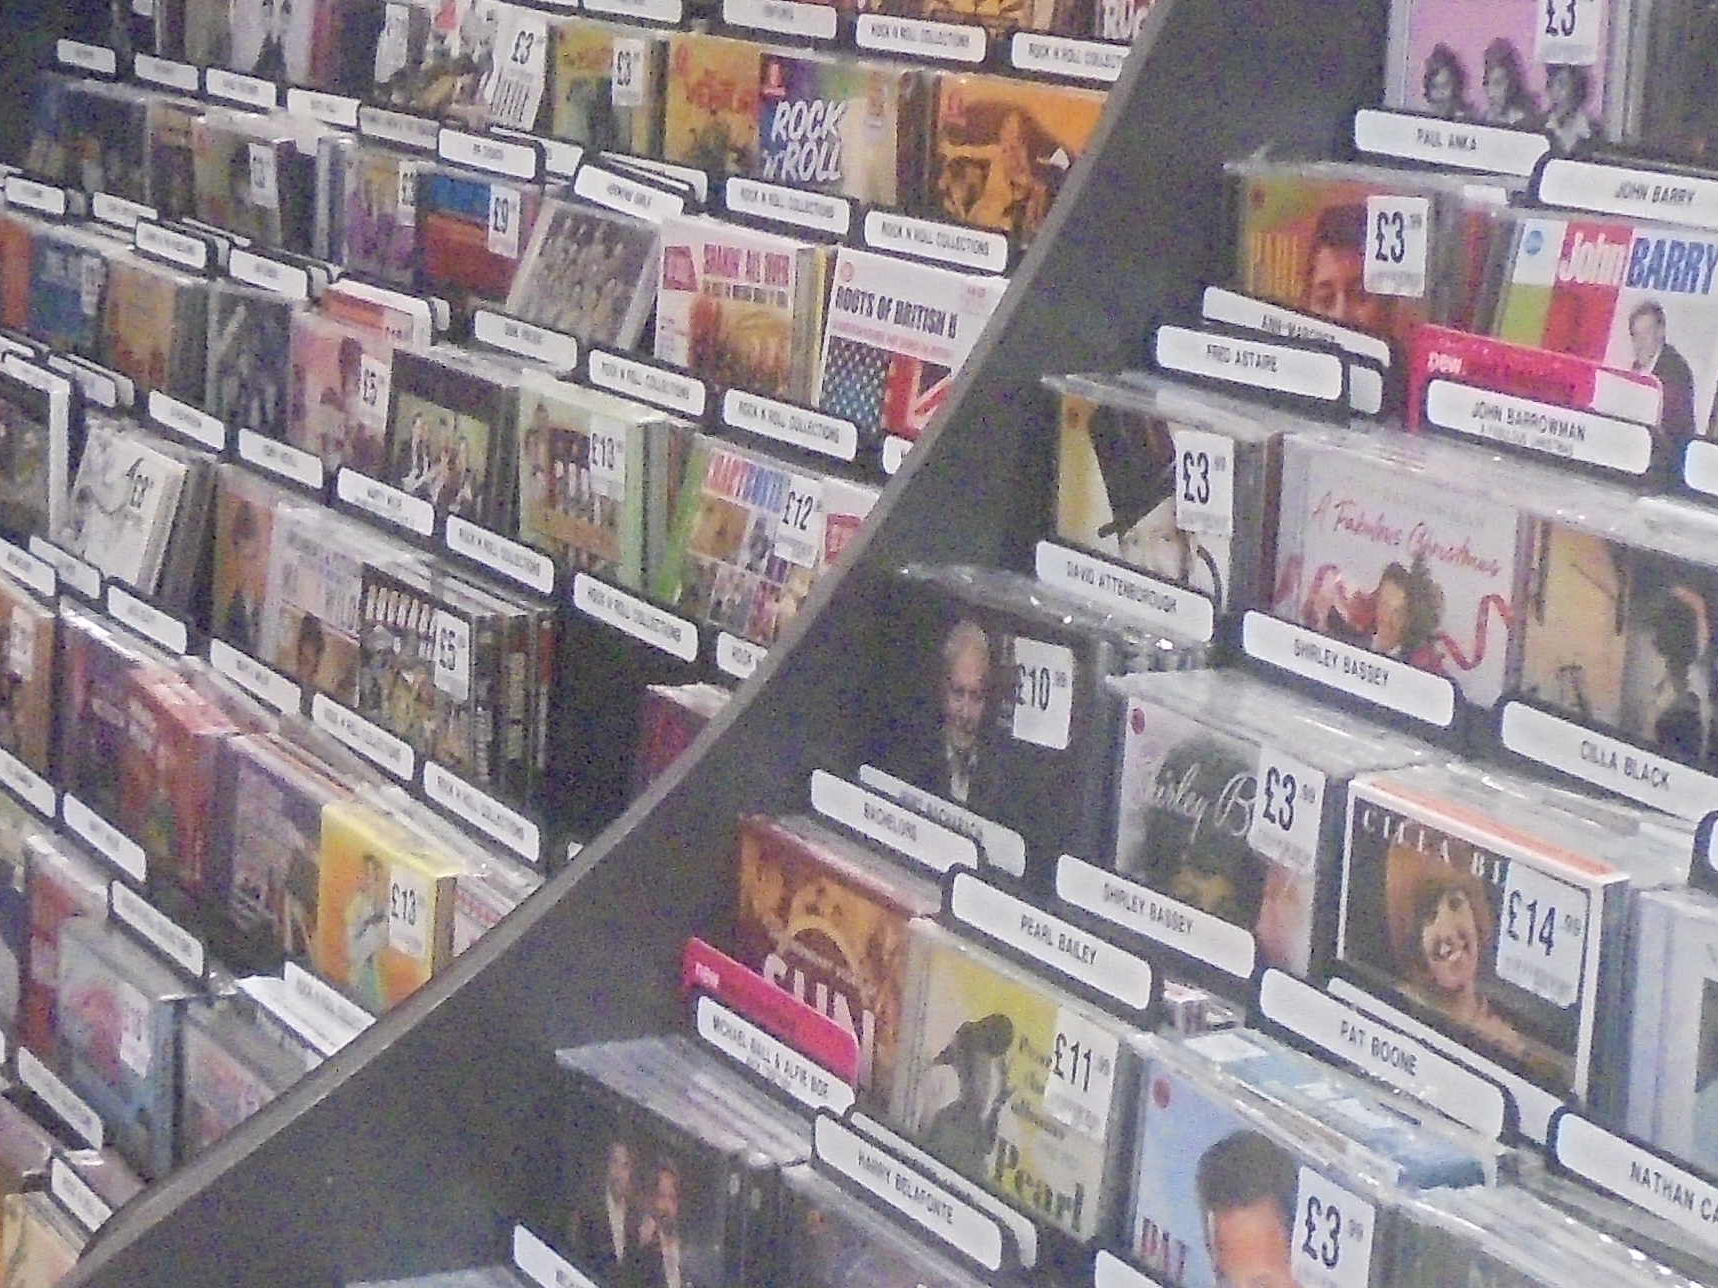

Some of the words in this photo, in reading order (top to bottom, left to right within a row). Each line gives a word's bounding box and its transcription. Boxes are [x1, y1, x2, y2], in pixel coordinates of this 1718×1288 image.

[770, 99, 847, 143] ROCK
[1416, 127, 1445, 150] PAUL
[1450, 132, 1478, 153] ANKA
[779, 142, 843, 184] ROLL
[1616, 183, 1648, 203] JOHN
[1652, 186, 1695, 207] BARRY
[1559, 232, 1630, 287] John
[878, 288, 892, 321] OF
[893, 293, 943, 339] BRITISH
[1206, 343, 1231, 363] FRED
[1235, 347, 1278, 374] ASTAIRE
[1427, 351, 1463, 374] new
[1472, 400, 1499, 421] JOHN
[1504, 405, 1586, 442] BARROWMAN
[1293, 640, 1339, 670] SHIRLEY
[1343, 654, 1389, 687] BASSEY
[1581, 740, 1619, 772] CILLA
[1622, 754, 1671, 791] BLACK
[1103, 882, 1146, 915] SHIRLEY
[1149, 900, 1194, 937] BASSEY
[1020, 915, 1053, 946] PEARL
[1056, 931, 1097, 967] BAILEY
[1340, 1020, 1366, 1046] PAT
[1370, 1036, 1417, 1075] BOONE
[1630, 1160, 1695, 1211] NATHAN
